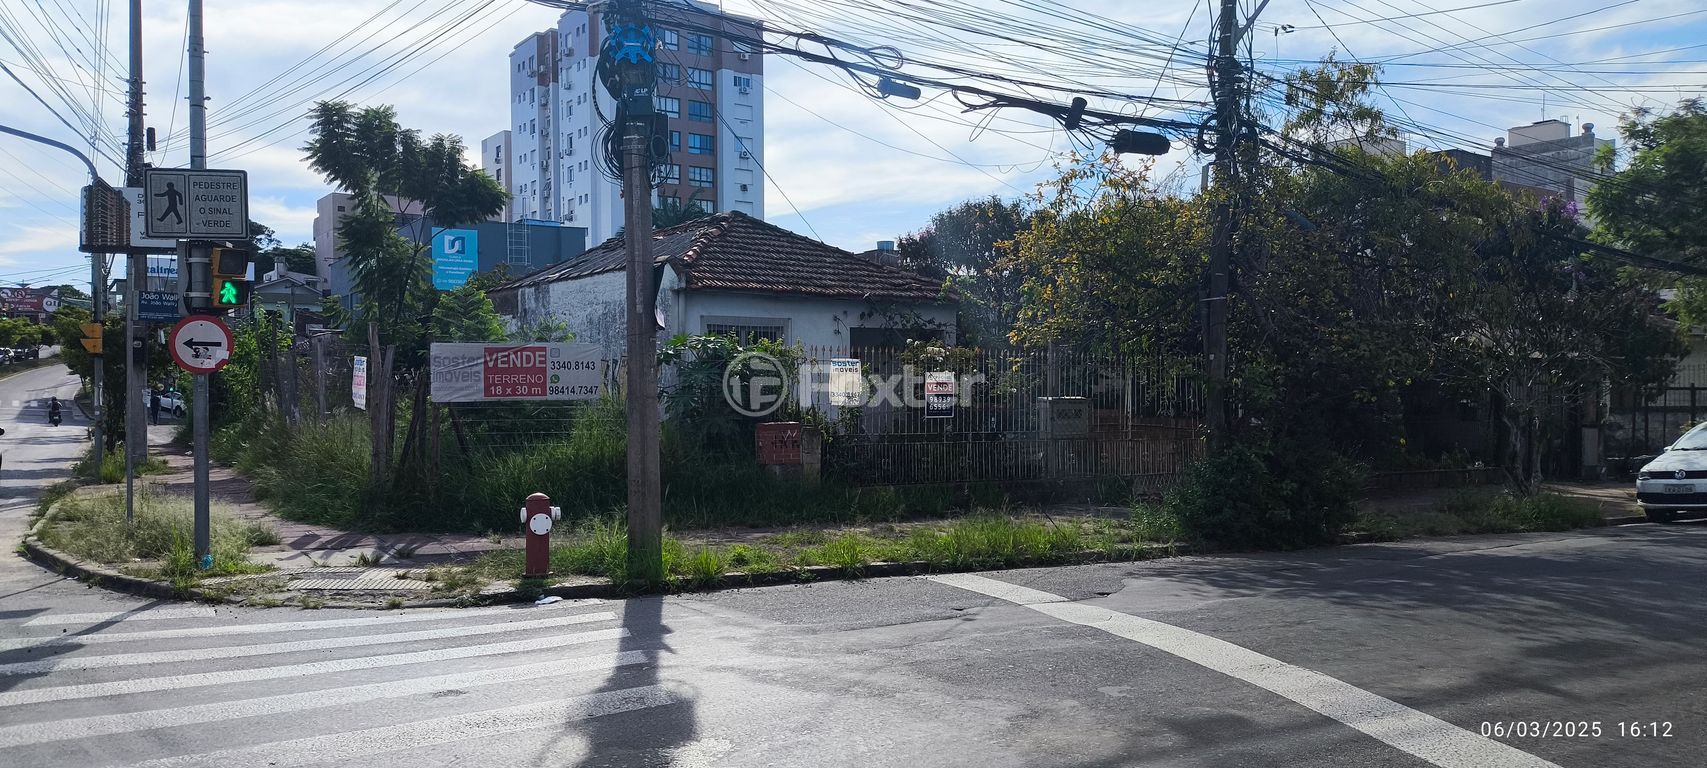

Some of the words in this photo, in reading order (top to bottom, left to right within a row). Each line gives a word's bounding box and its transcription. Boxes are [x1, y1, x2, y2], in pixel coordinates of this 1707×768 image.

[192, 182, 238, 190] PEDESTRE
[194, 194, 236, 202] AGUARDE
[208, 207, 232, 215] SINAL
[202, 220, 230, 228] VERDE
[485, 352, 546, 368] VENDE
[550, 361, 595, 370] 3340.8143
[488, 374, 544, 384] TERRENO
[490, 386, 502, 394] 18
[516, 386, 528, 394] 30
[549, 386, 598, 395] 98414.7347
